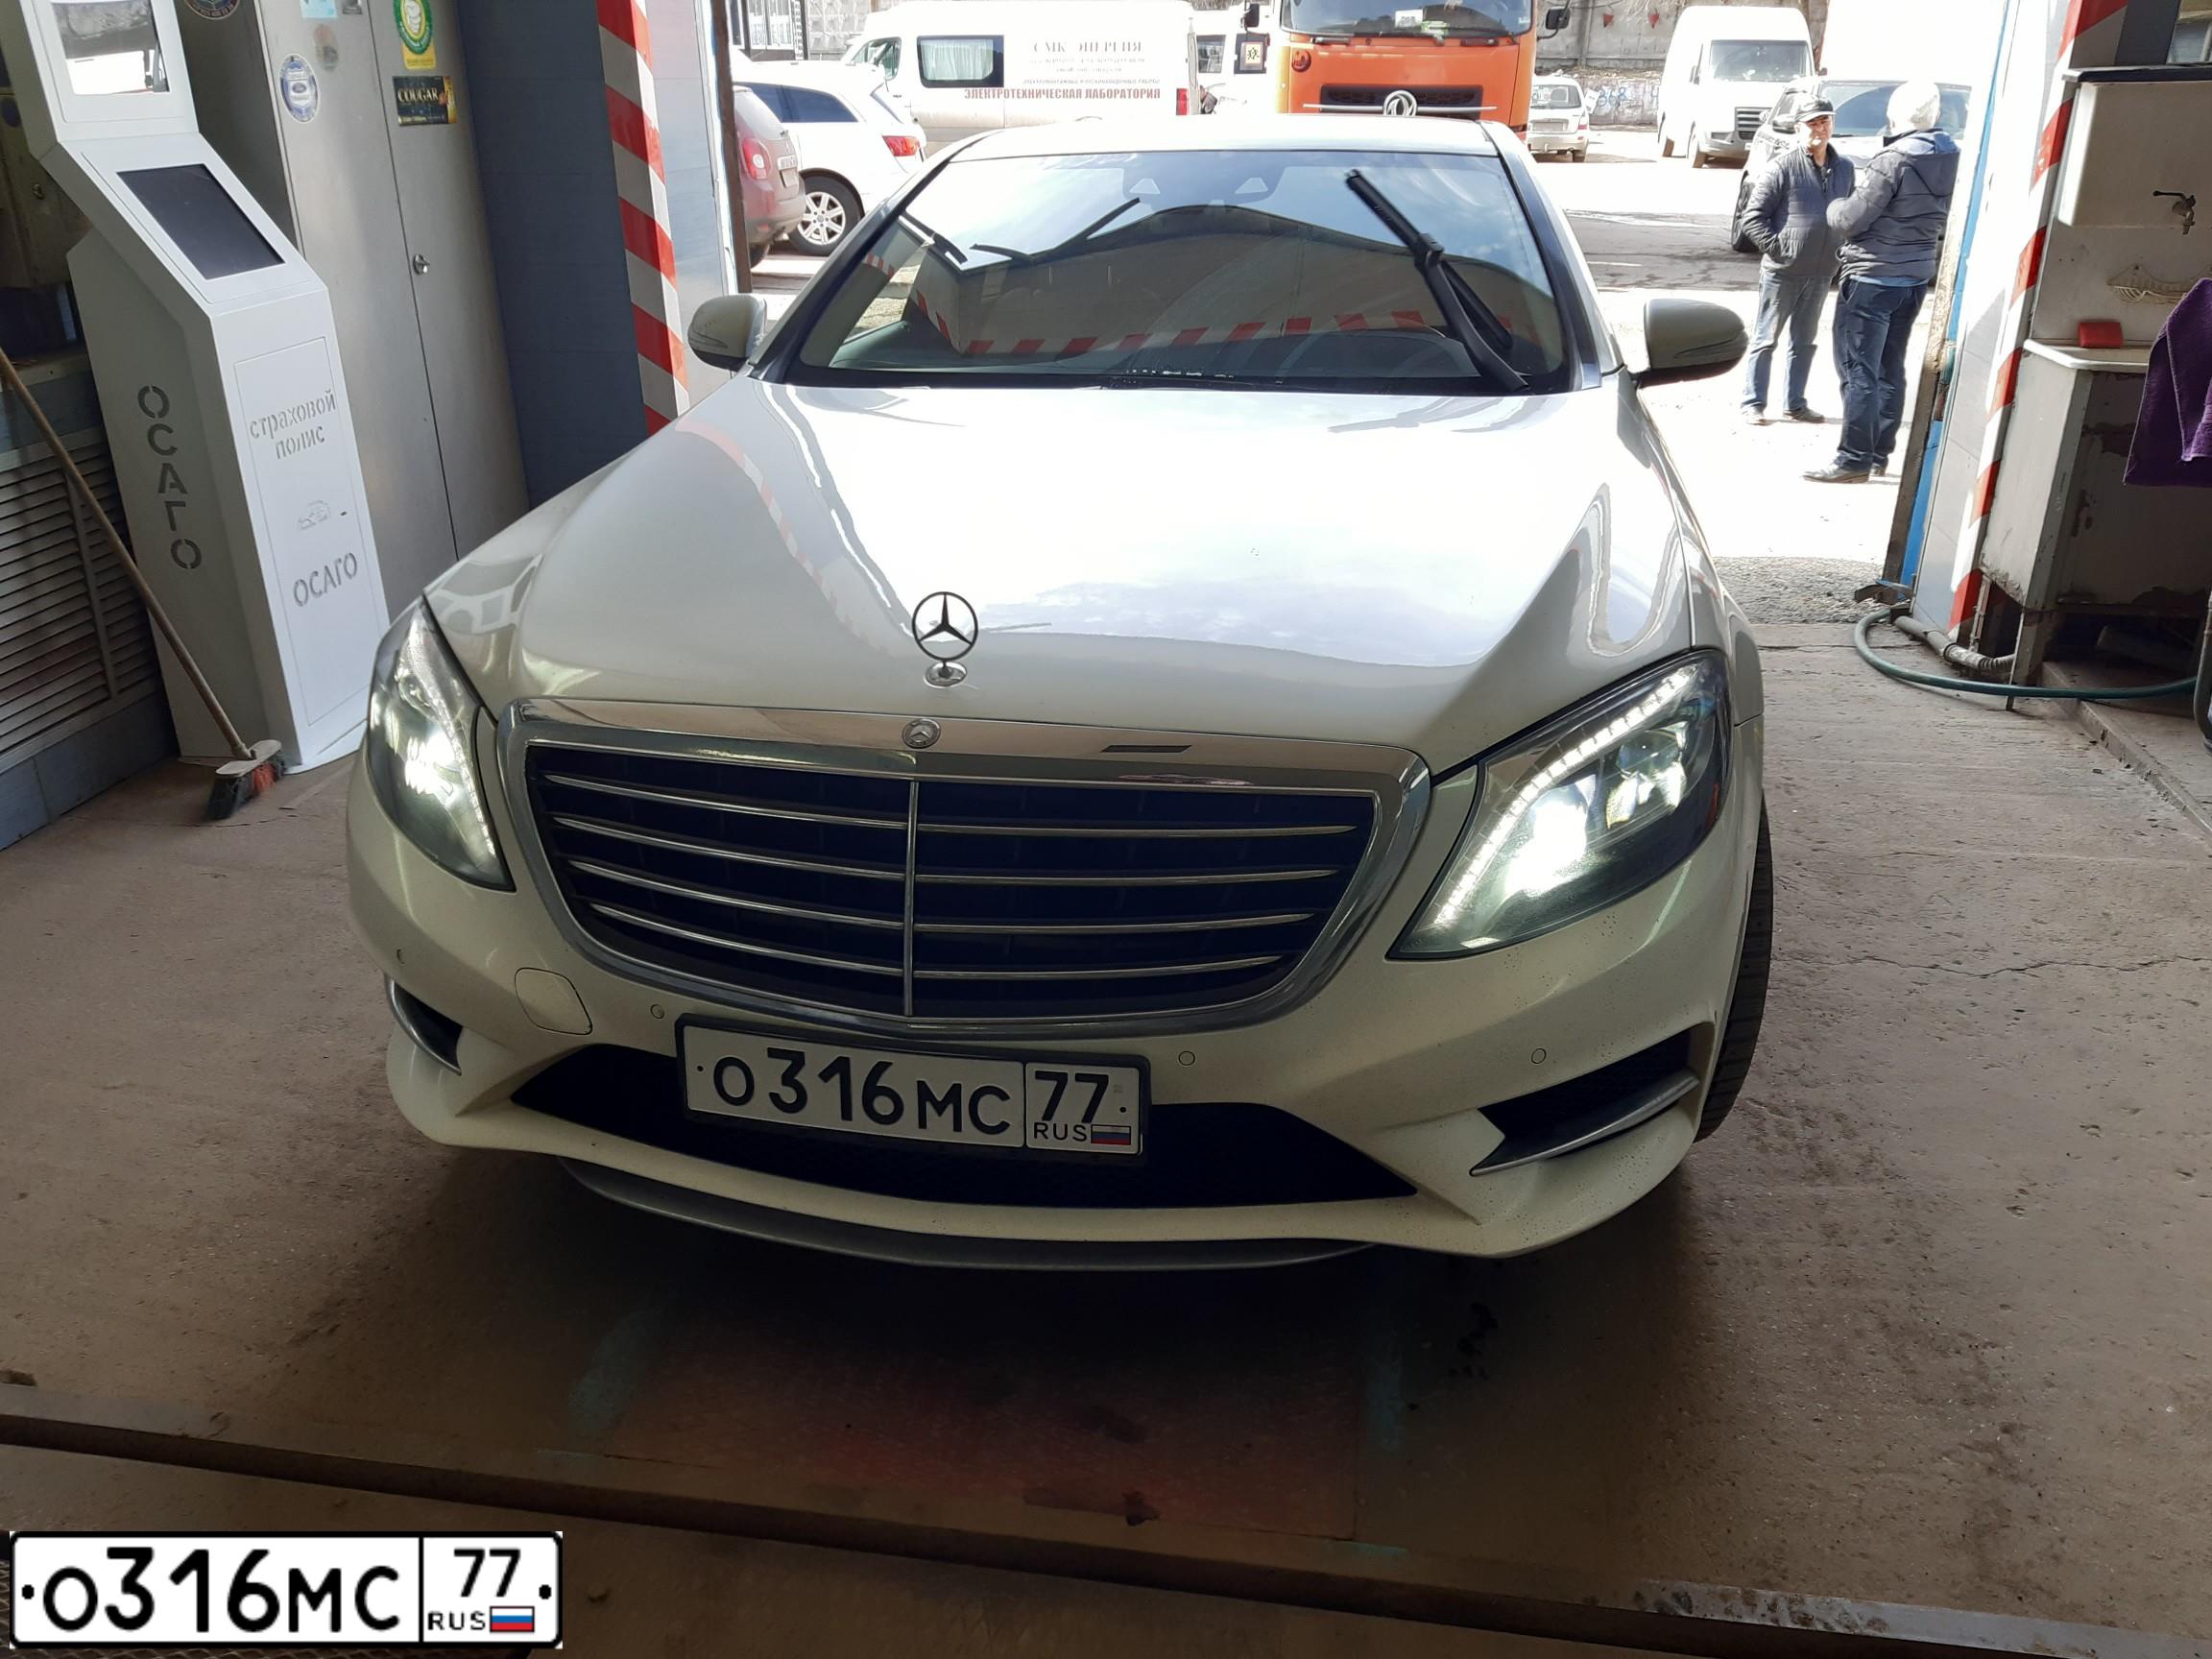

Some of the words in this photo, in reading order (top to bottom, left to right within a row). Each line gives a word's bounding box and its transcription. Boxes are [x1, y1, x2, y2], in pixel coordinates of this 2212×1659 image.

[397, 87, 439, 103] COUGAR
[964, 88, 1082, 99] ЭЛЕКТРОТЕХНИЧЕСКАЯ
[1085, 88, 1160, 99] ЛАБОРАТОРИЯ
[250, 389, 336, 440] страховой
[276, 425, 325, 460] полис
[137, 385, 203, 569] ОСАГО
[294, 552, 357, 607] ОСАГО
[712, 1047, 1011, 1135] О316МС
[1034, 1070, 1110, 1124] 77
[1033, 1121, 1088, 1142] RUS
